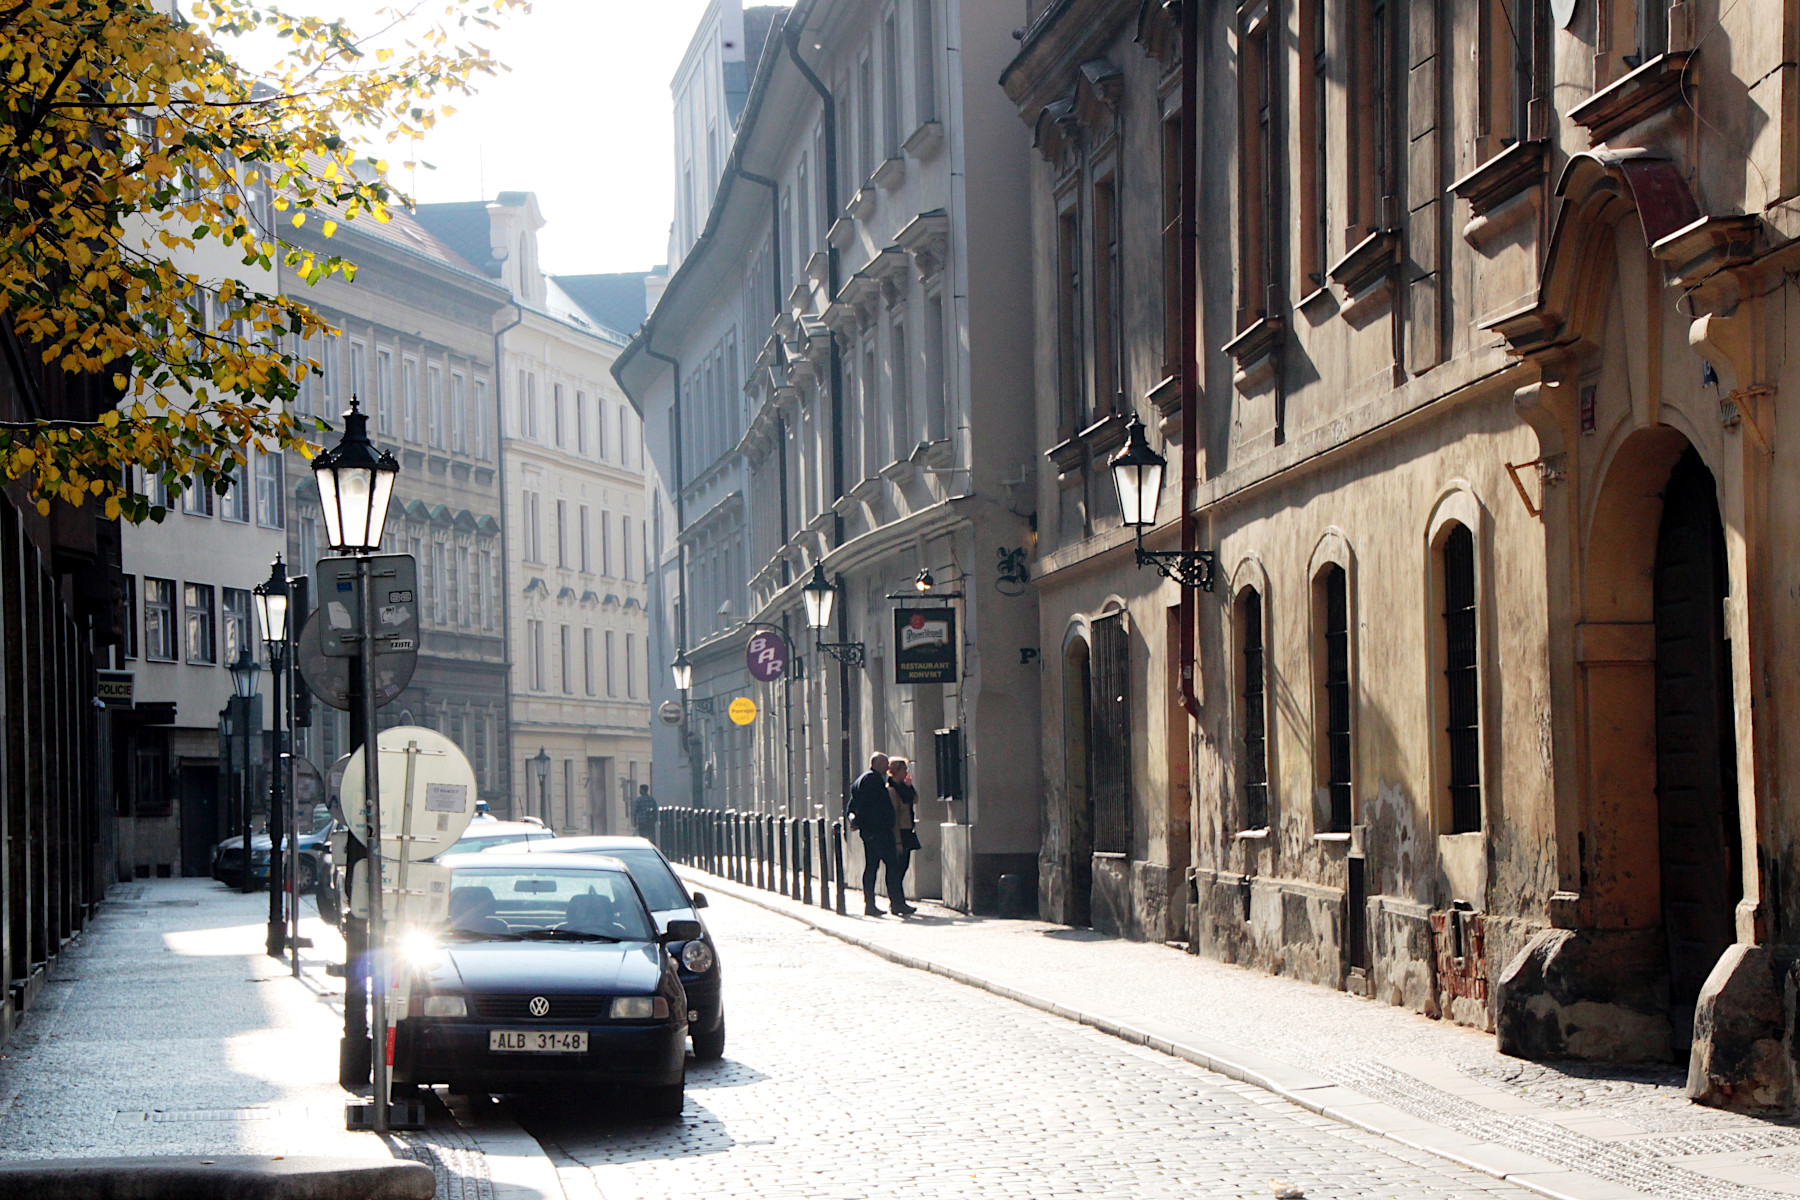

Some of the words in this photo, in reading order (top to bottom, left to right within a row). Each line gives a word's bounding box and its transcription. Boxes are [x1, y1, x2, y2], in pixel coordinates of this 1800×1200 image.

[750, 637, 783, 676] BAR
[901, 662, 950, 670] RESTAURANT
[98, 684, 132, 695] POLICIE
[497, 1033, 526, 1049] ALB
[538, 1034, 581, 1050] 31-48
